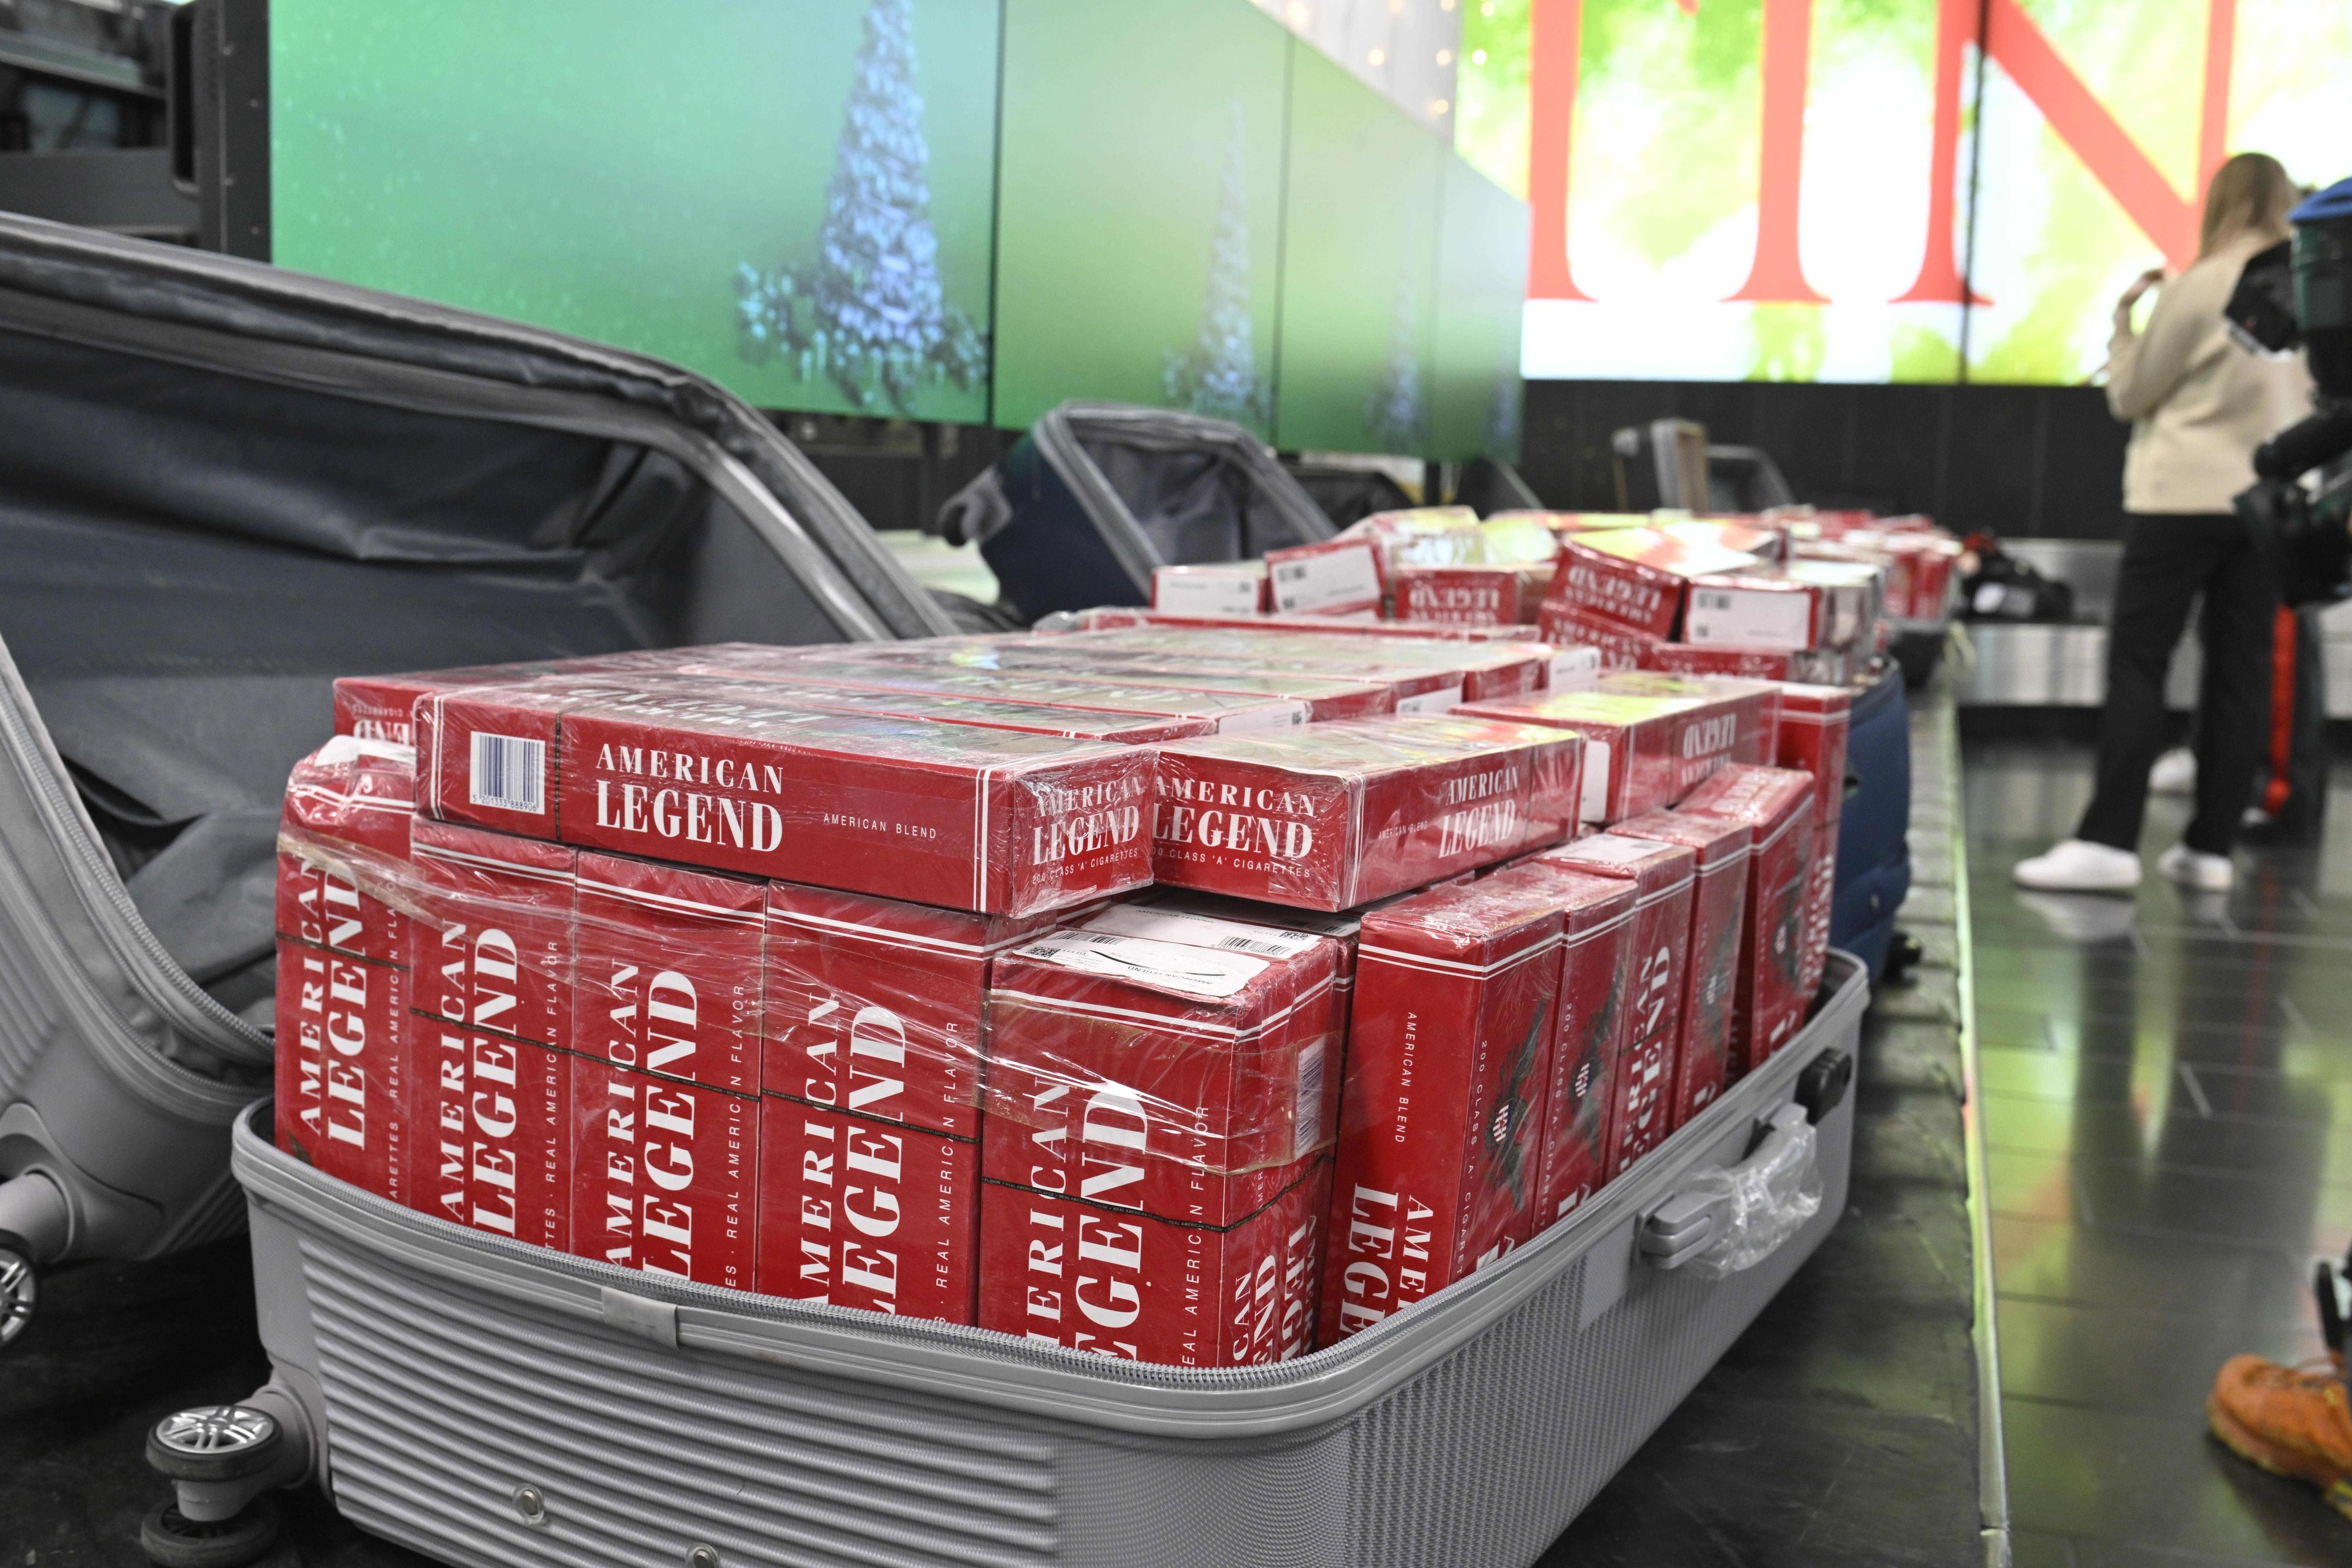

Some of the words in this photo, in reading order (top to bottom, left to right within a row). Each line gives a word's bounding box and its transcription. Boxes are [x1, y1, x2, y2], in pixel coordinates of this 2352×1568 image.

[472, 794, 477, 803] 5
[596, 743, 783, 794] AMERICAN
[1033, 775, 1144, 819] AMERICAN
[1156, 775, 1316, 817] AMERICAN
[1446, 766, 1519, 805] AMERICAN
[596, 780, 783, 852] LEGEND
[823, 813, 888, 833] AMERICAN
[896, 824, 937, 840] BLEND
[1033, 805, 1140, 865] LEGEND
[1152, 803, 1312, 859] LEGEND
[1378, 825, 1406, 839] AMERICAN
[1439, 798, 1516, 859] LEGEND
[1050, 865, 1074, 879] CLASS
[1091, 848, 1138, 868] CIGARETTES
[1170, 849, 1205, 862] CLASS
[1234, 858, 1311, 878] CIGARETTES
[323, 859, 367, 1151] LEGEND
[389, 950, 399, 1045] AMERICN
[548, 941, 558, 1015] FLAVOR
[731, 984, 744, 1064] FLAVOR
[1563, 1002, 1572, 1032] 200
[390, 1058, 399, 1098] REAL
[440, 918, 466, 1222] AMERICAN
[943, 1022, 958, 1103] FLAVOR
[1401, 1011, 1417, 1088] AMERICAN
[1478, 1039, 1487, 1072] 200
[1555, 1042, 1568, 1099] CLASS
[473, 928, 517, 1237] LEGEND
[606, 957, 639, 1266] AMERICAN
[643, 970, 698, 1281] LEGEND
[729, 1076, 741, 1178] AMERICN
[1395, 1096, 1409, 1143] BLEND
[1471, 1084, 1483, 1146] CLASS
[546, 1138, 556, 1182] REAL
[842, 1006, 906, 1315] EGEND
[938, 1116, 954, 1225] AMERICN
[1191, 1106, 1209, 1191] FLAVOR
[727, 1193, 739, 1239] REAL
[1027, 1077, 1070, 1345] ERICAN
[1075, 1089, 1148, 1364] EGEND
[1455, 1192, 1471, 1274] CIGARET
[936, 1239, 948, 1288] REAL
[1185, 1205, 1202, 1316] AMERICN
[1339, 1182, 1398, 1335] LEGE
[1182, 1329, 1197, 1366] EAL
